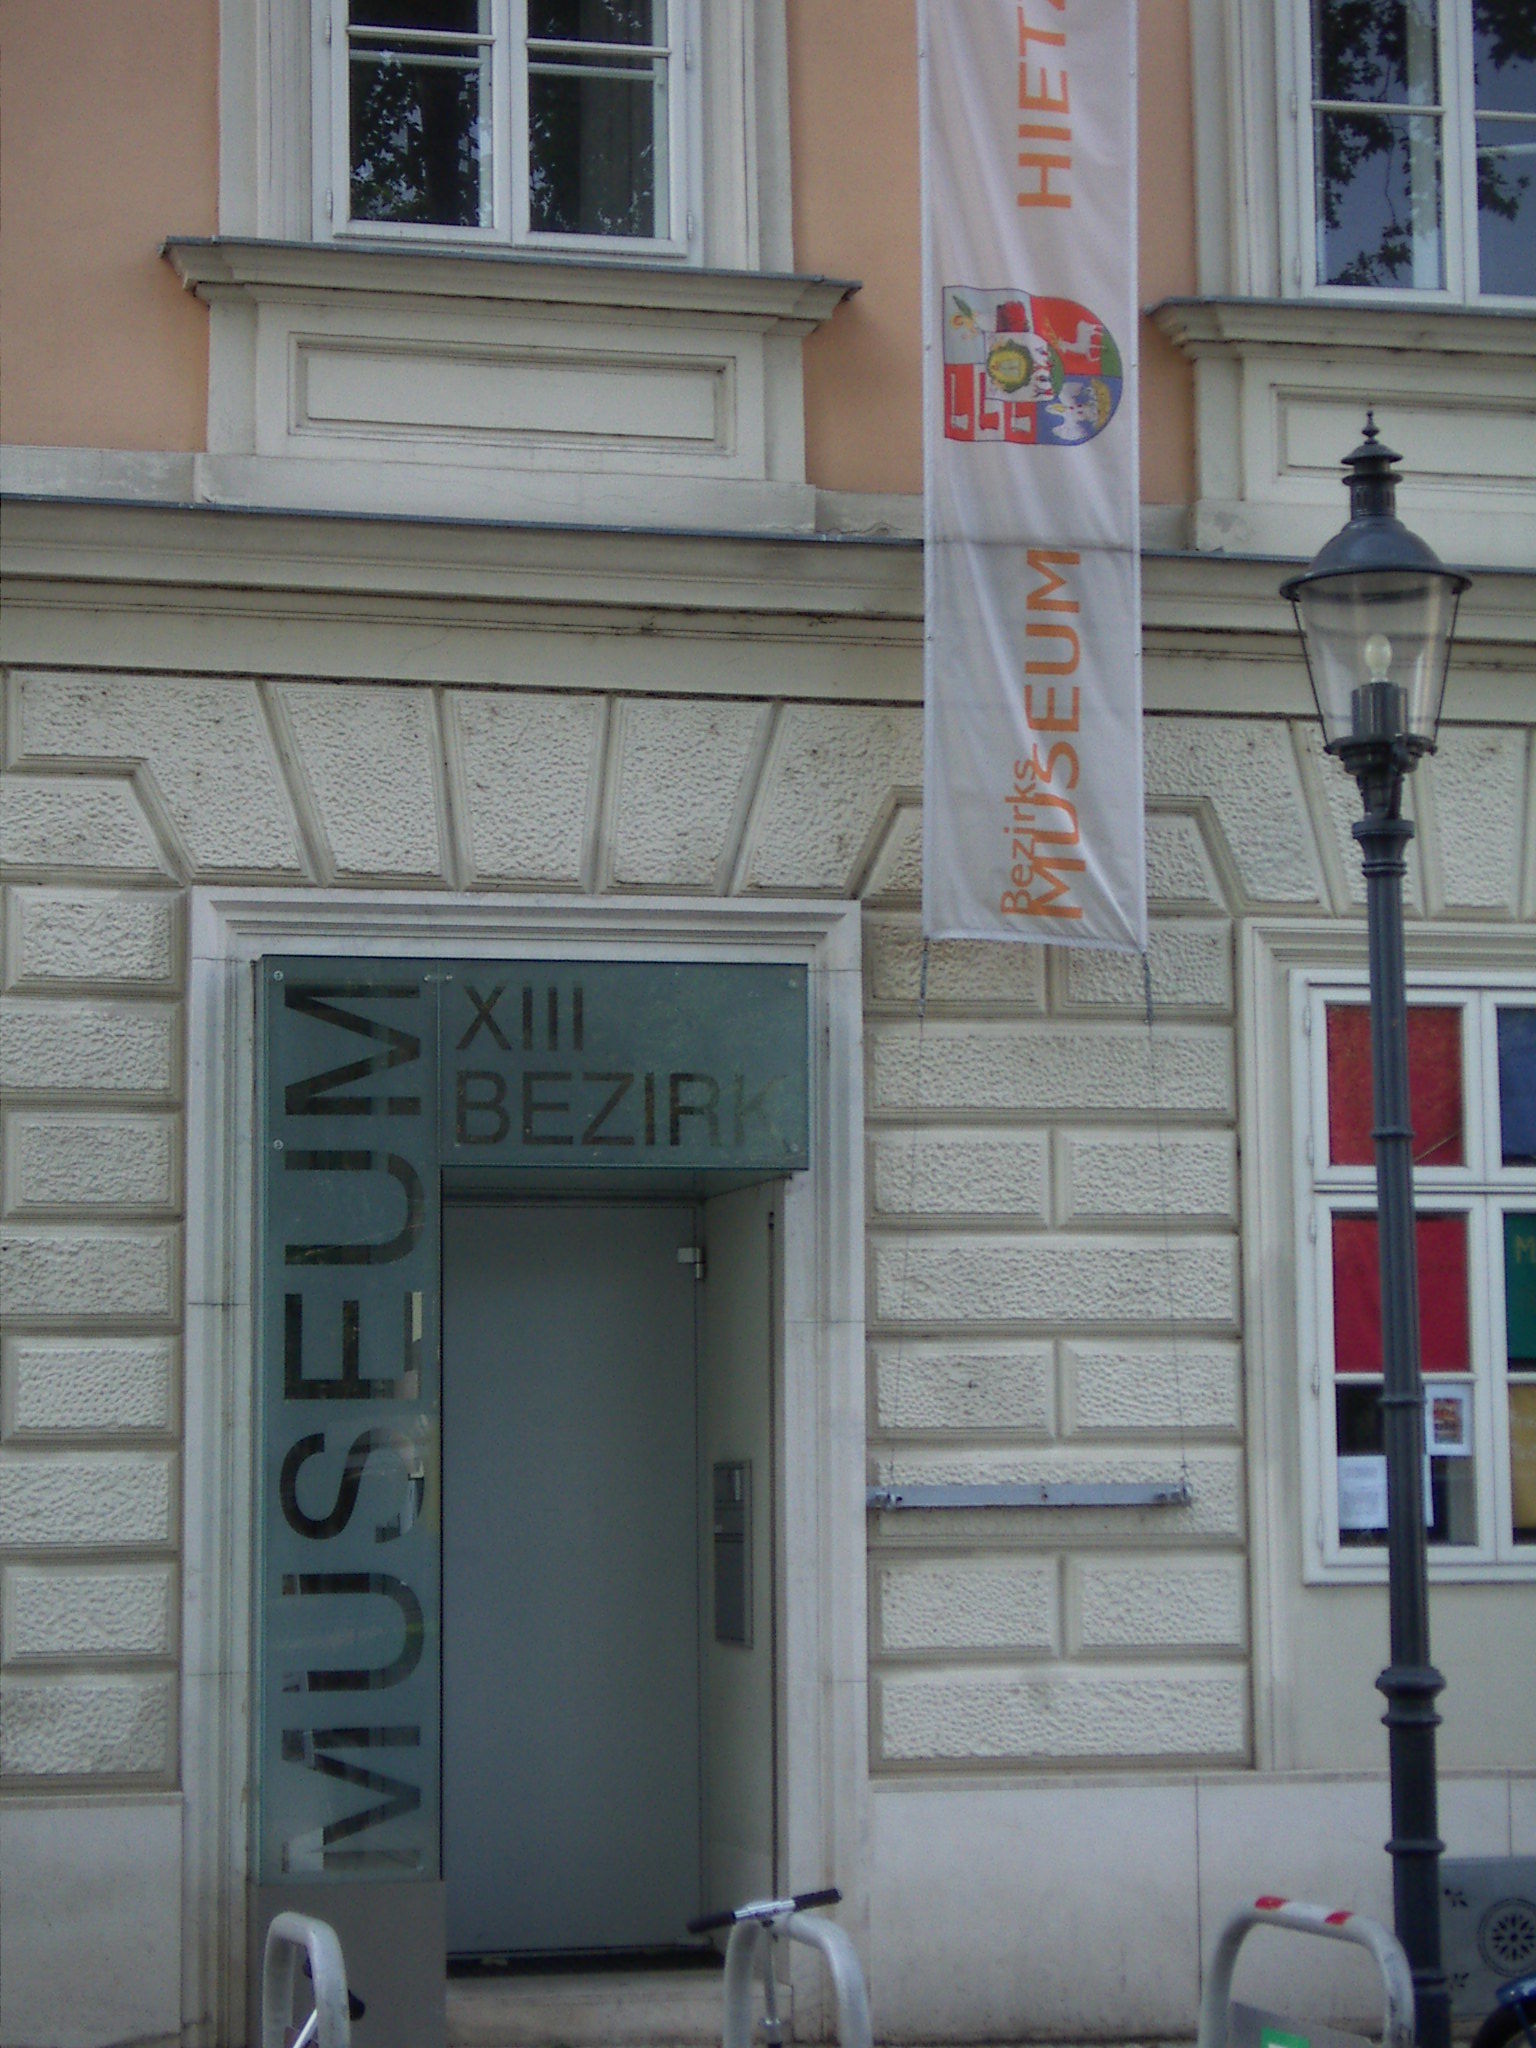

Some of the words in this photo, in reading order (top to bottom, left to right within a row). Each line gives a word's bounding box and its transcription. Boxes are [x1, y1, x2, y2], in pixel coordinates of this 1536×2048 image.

[1016, 0, 1072, 208] HIET
[1024, 549, 1086, 919] MUSEUM
[1000, 757, 1037, 916] Bezirks
[456, 985, 585, 1051] XIII
[456, 1070, 790, 1147] BEZIRK
[281, 983, 424, 1872] MUSEUM
